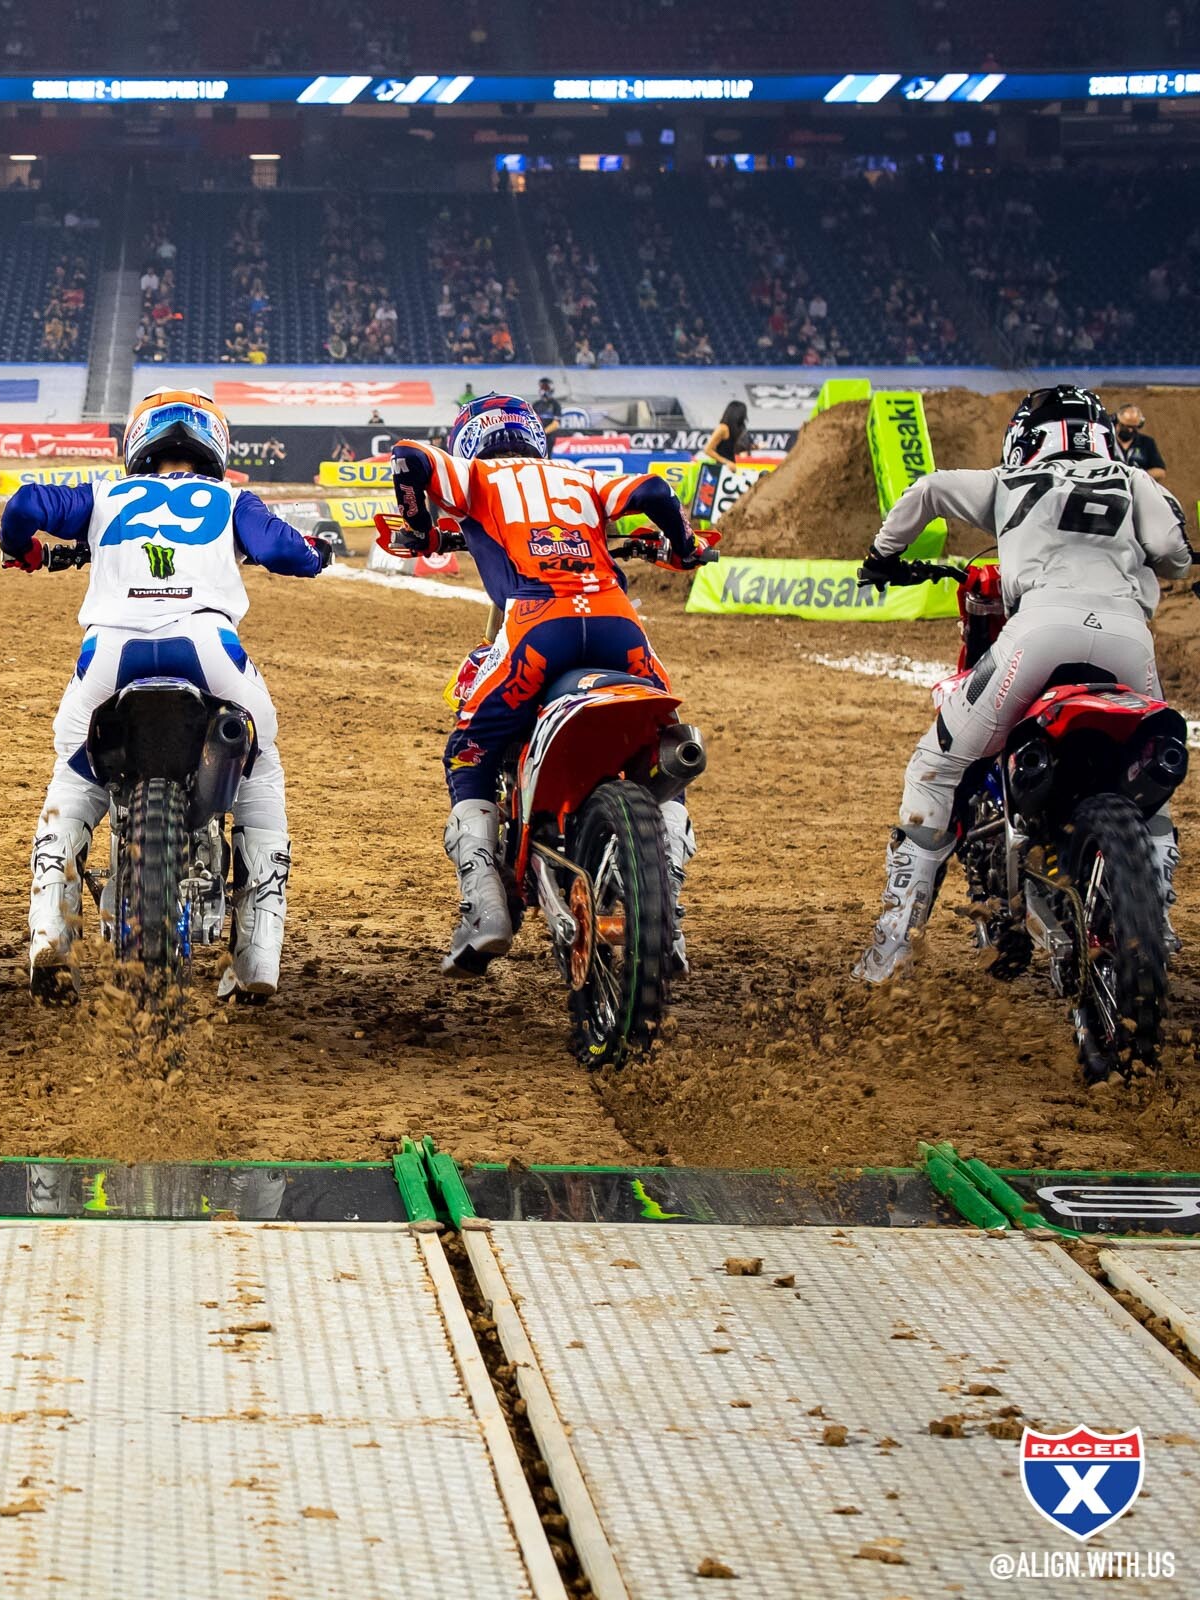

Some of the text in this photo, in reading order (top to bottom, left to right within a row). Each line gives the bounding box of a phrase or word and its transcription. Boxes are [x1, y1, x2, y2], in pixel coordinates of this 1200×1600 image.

[56, 447, 112, 457] HONDA
[571, 444, 627, 454] HONDA
[887, 399, 927, 489] wasaki
[100, 480, 231, 546] 29
[487, 464, 600, 528] 115
[999, 473, 1131, 537] 76
[530, 542, 590, 558] Red Bull
[502, 643, 547, 710] KTM
[998, 649, 1024, 699] HONDA
